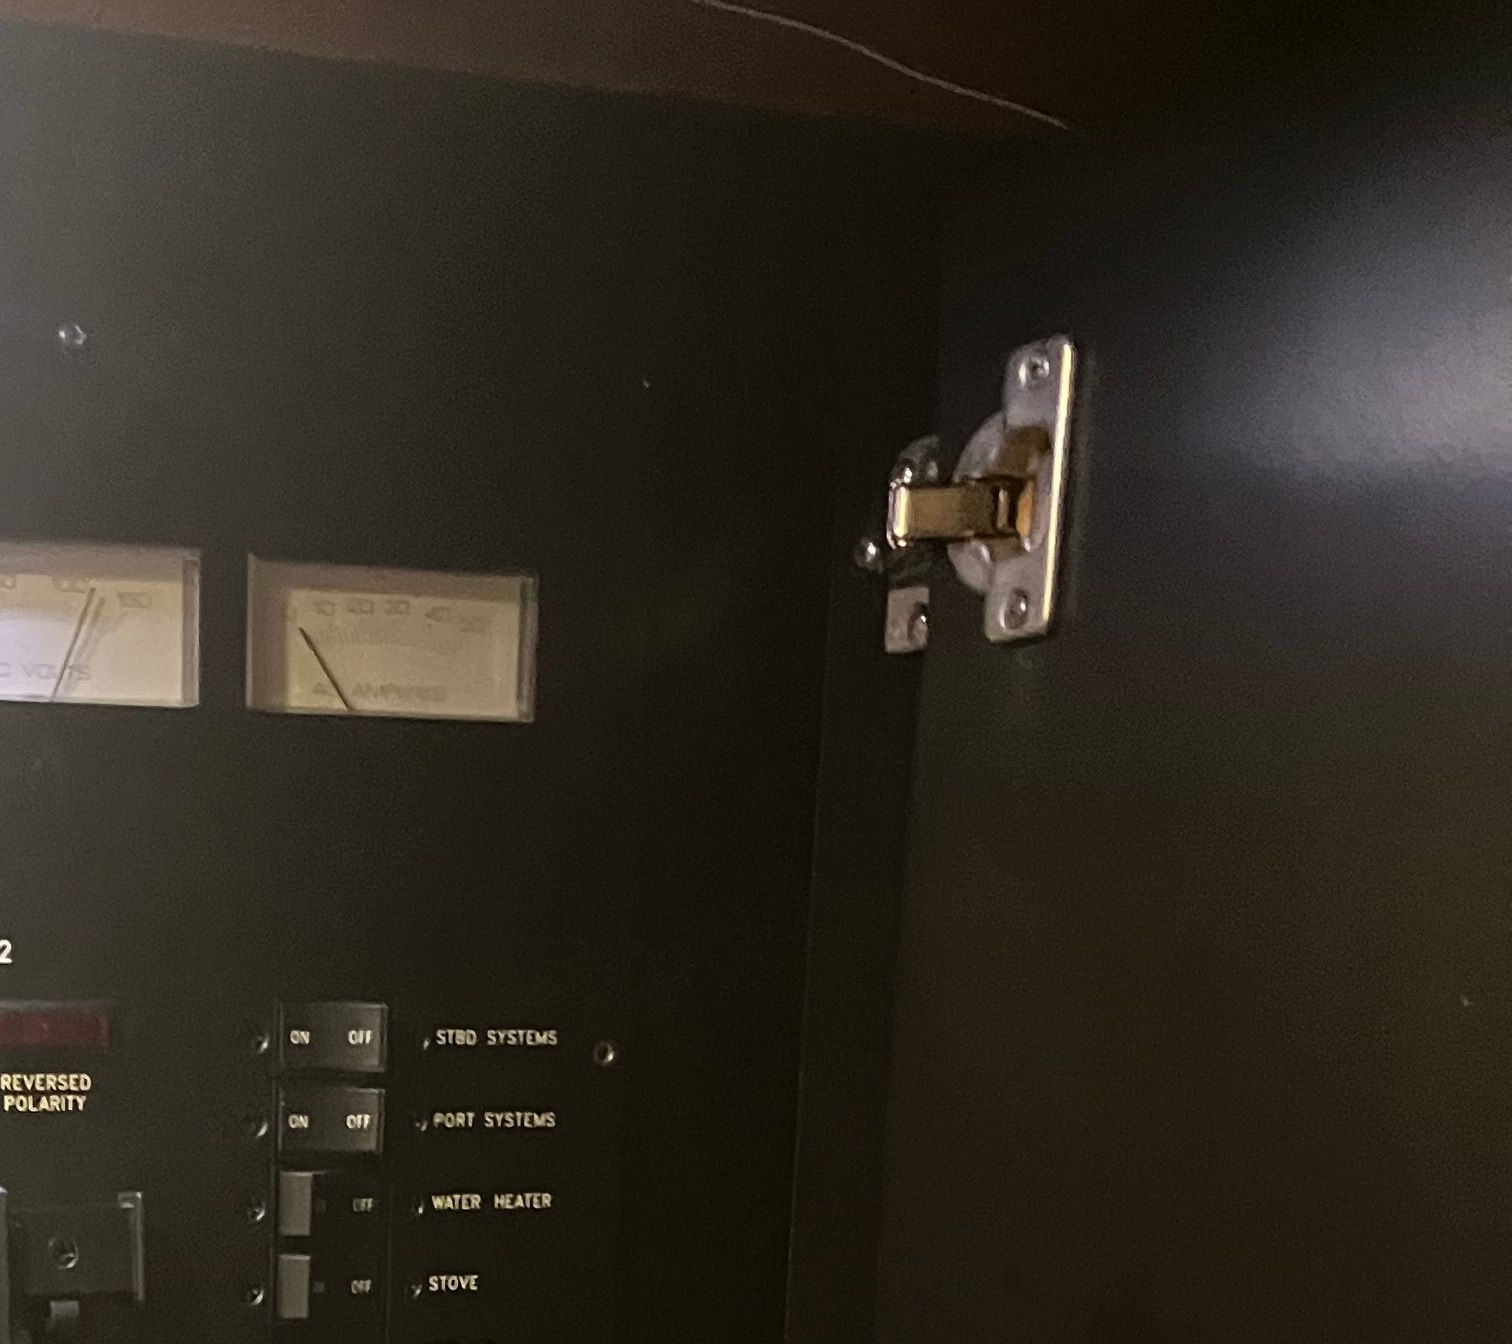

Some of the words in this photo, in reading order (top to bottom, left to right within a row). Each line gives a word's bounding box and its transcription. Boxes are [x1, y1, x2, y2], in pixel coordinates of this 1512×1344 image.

[290, 1031, 309, 1044] ON
[349, 1031, 371, 1044] OFF
[437, 1029, 477, 1045] STBD
[488, 1030, 557, 1045] SYSTEMS
[1, 1074, 91, 1090] REVERSED
[4, 1095, 86, 1111] POLARITY
[434, 1112, 474, 1127] PORT
[485, 1112, 555, 1127] SYSTEMS
[432, 1194, 481, 1209] WATER
[495, 1193, 551, 1209] HEATER
[429, 1275, 478, 1291] STOVE
